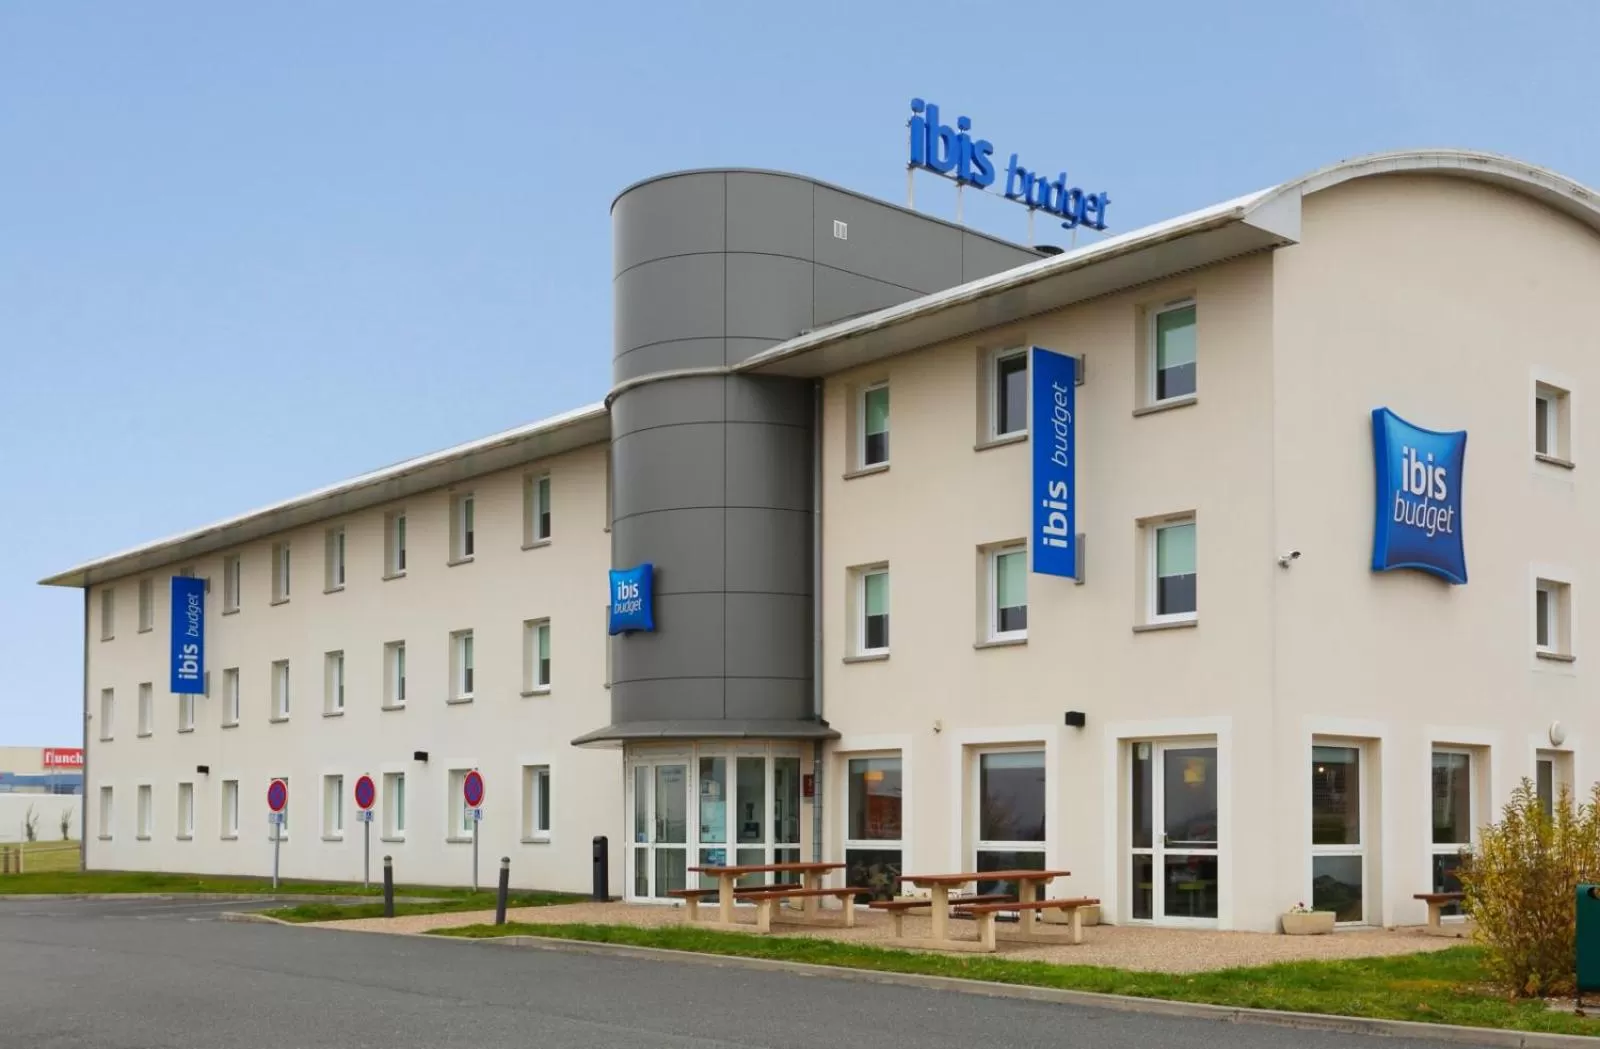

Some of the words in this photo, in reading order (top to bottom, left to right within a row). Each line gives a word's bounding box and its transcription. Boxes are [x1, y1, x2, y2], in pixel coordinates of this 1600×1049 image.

[910, 98, 995, 189] ibis
[1005, 153, 1111, 230] budget
[1051, 382, 1071, 467] budget
[1402, 446, 1447, 501] ibis
[1043, 480, 1068, 548] ibis
[1393, 490, 1454, 537] budget
[614, 598, 642, 615] budget
[617, 579, 639, 600] ibis
[186, 593, 202, 637] budget
[178, 643, 199, 680] ibis
